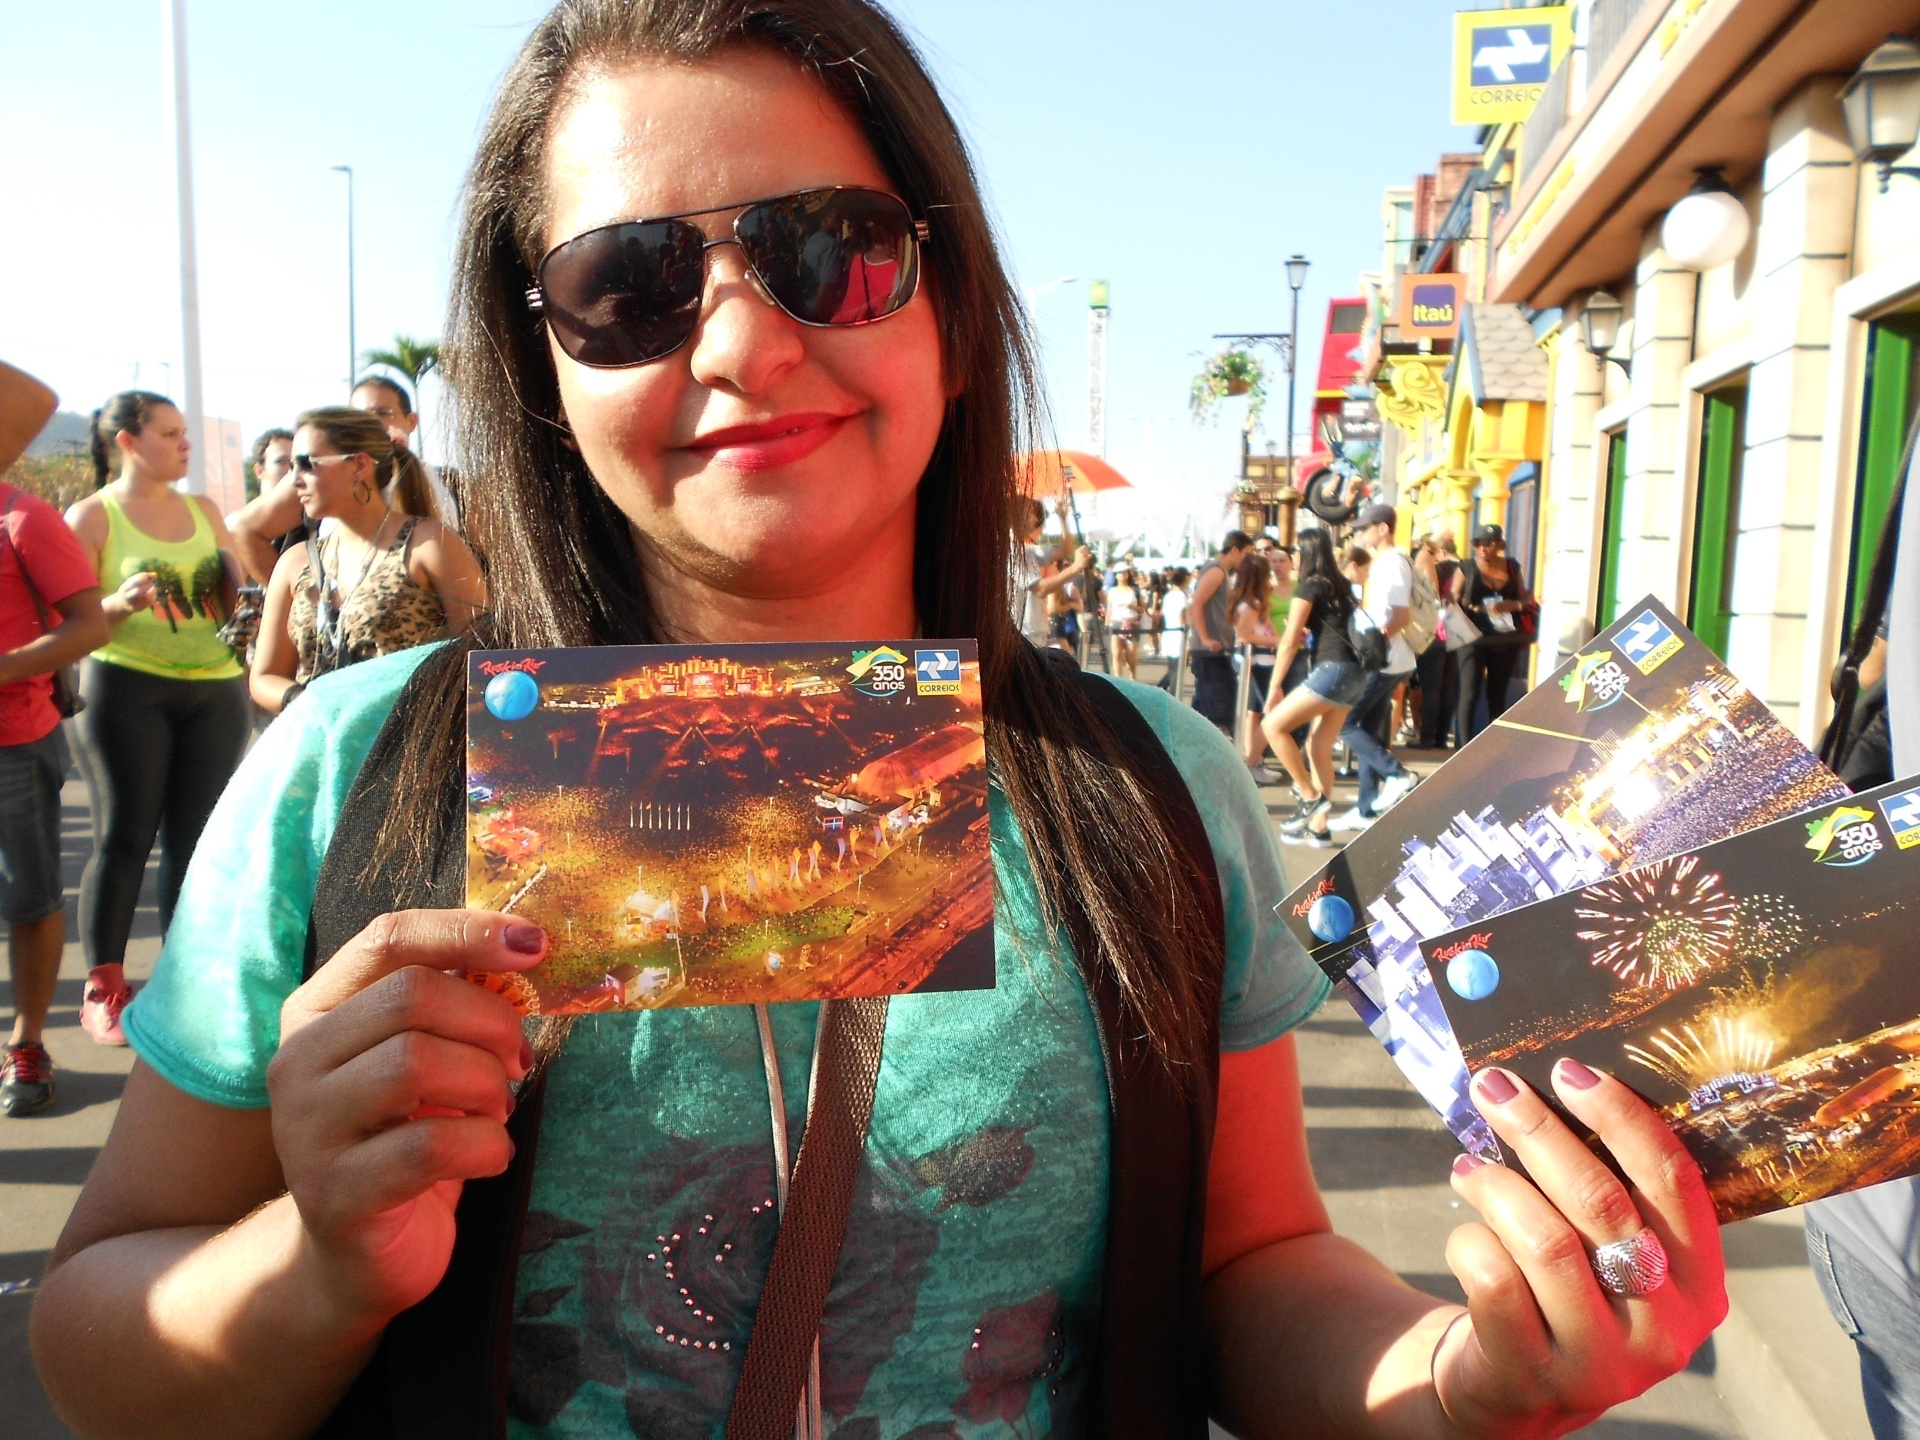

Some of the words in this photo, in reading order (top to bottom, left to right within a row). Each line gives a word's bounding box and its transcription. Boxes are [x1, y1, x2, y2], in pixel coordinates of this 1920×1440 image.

[1470, 87, 1542, 105] CORREIO
[1413, 303, 1453, 322] Itaú
[1641, 638, 1680, 672] CORREIOS
[872, 664, 905, 682] 350
[1586, 660, 1622, 694] 350
[872, 680, 906, 691] anos
[918, 684, 960, 693] CORREIOS
[1598, 673, 1630, 701] anos
[1835, 821, 1878, 850] 350
[1843, 839, 1884, 860] anos
